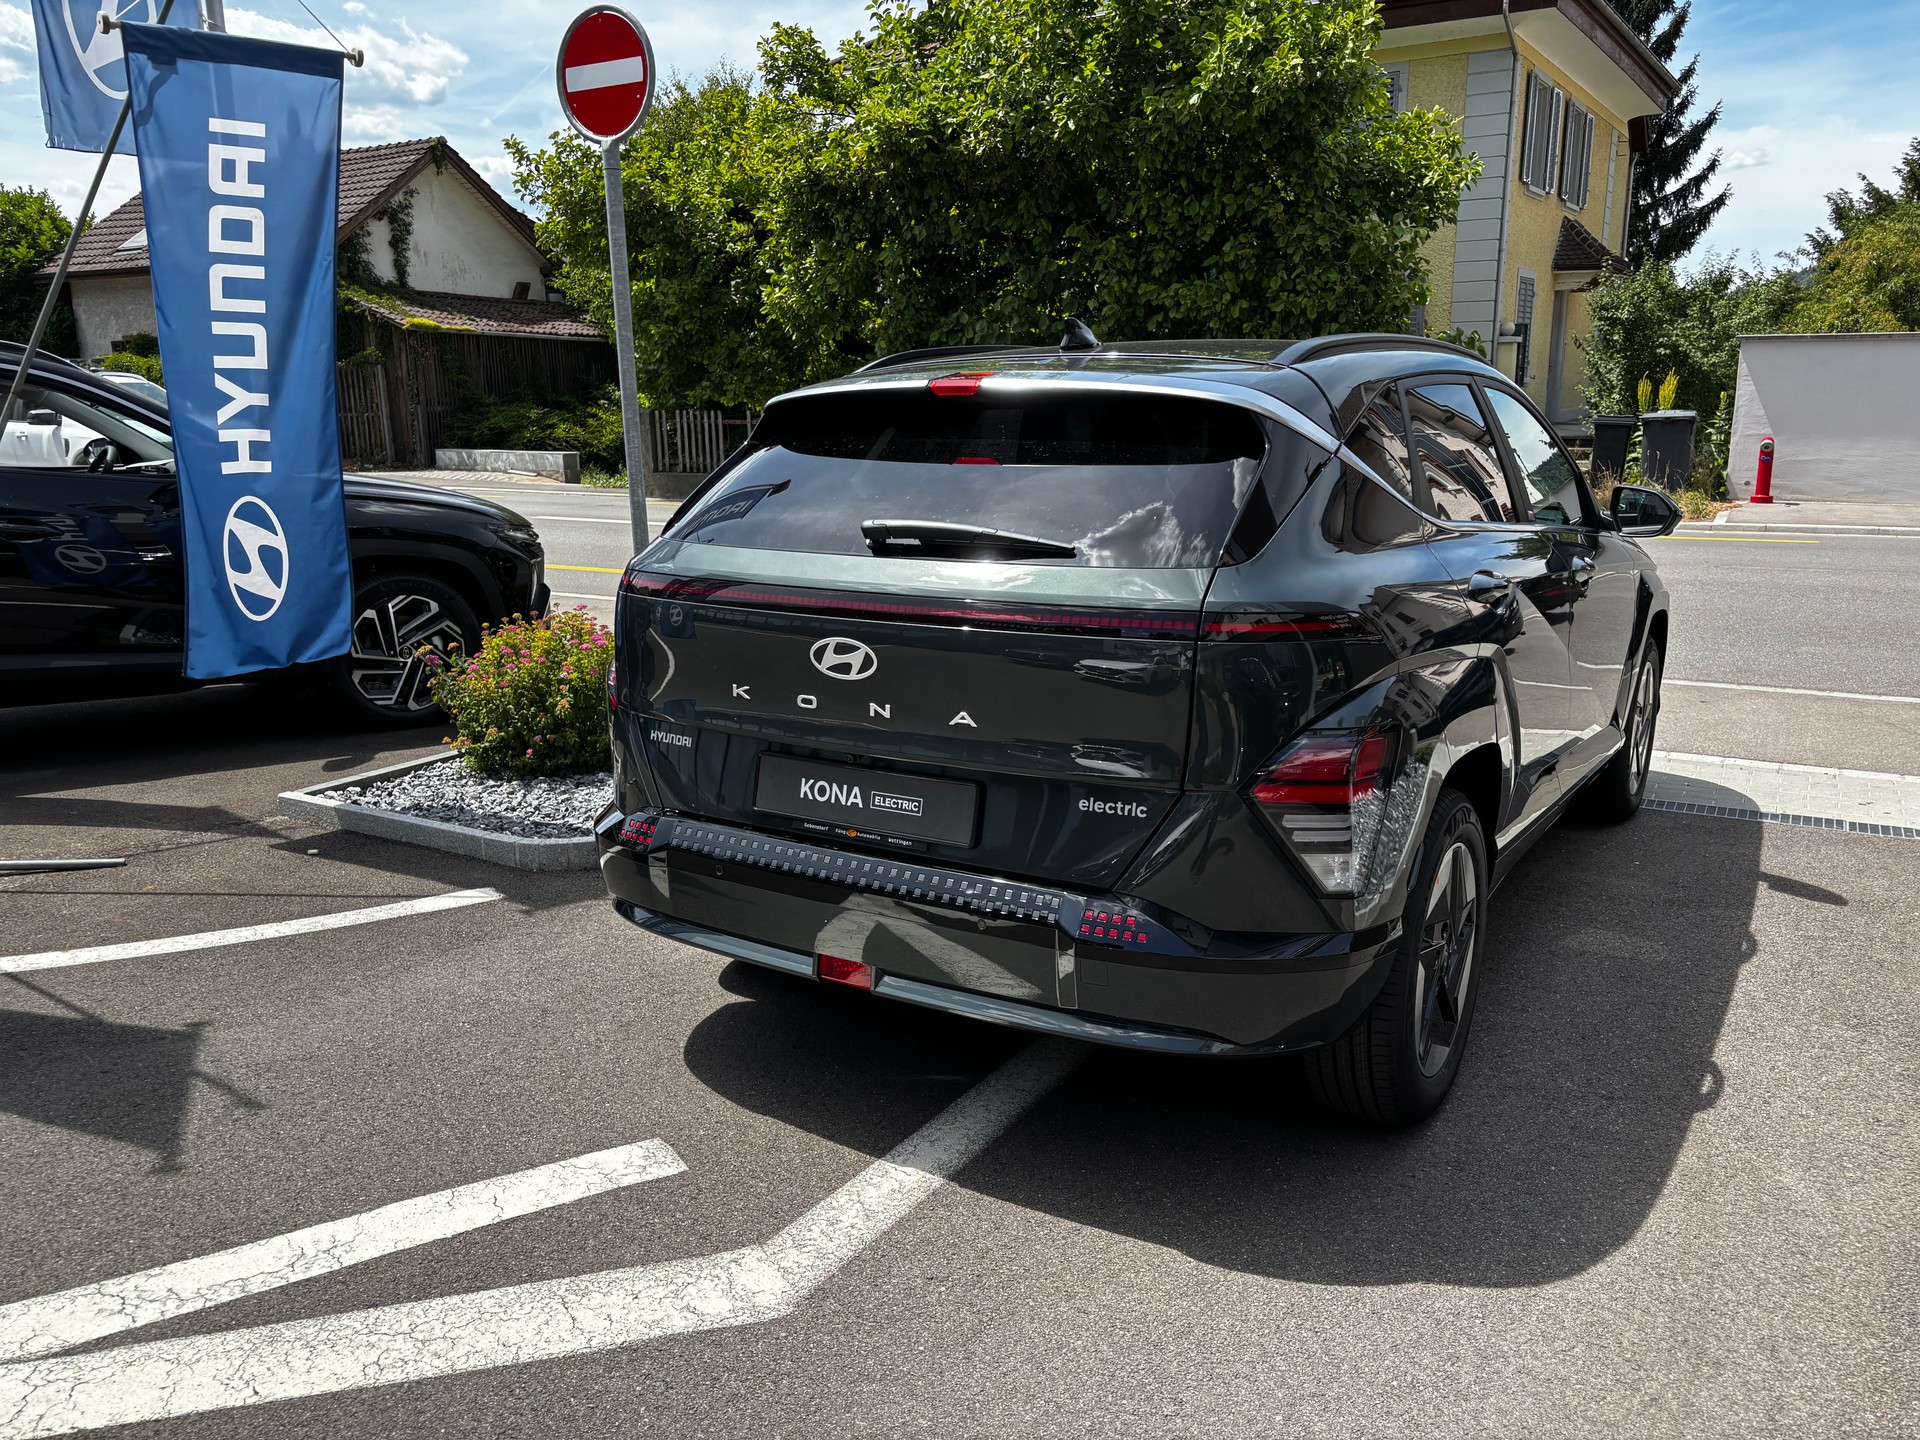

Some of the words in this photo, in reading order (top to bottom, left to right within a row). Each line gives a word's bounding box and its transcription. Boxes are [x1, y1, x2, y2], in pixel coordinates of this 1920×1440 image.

[208, 117, 272, 475] HYUNDAI
[732, 684, 977, 728] KONA
[650, 730, 692, 748] HYUNDAI
[800, 778, 863, 808] KONA
[875, 796, 919, 811] ELECTRIC
[1078, 797, 1148, 818] electric
